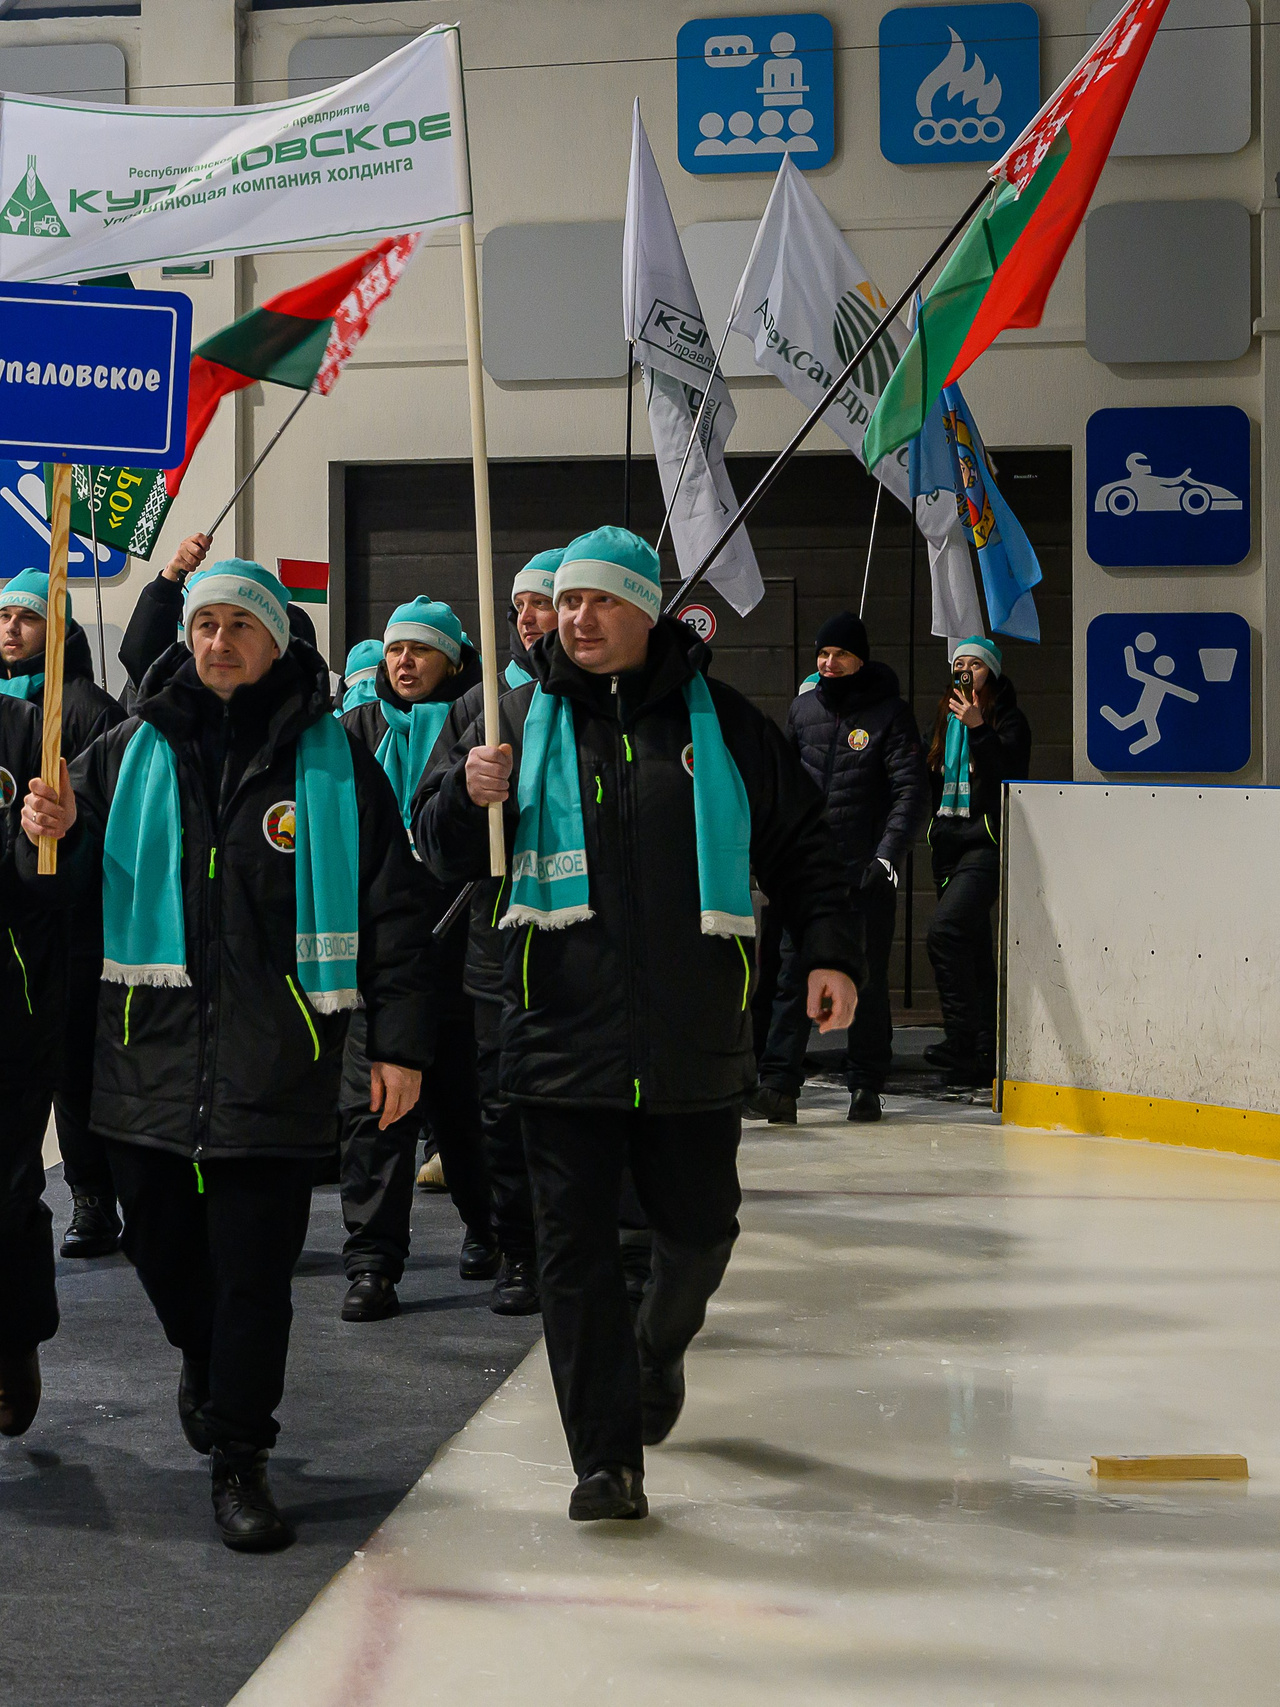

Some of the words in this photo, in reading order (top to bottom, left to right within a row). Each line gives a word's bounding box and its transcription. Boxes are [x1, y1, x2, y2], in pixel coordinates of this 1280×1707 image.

[128, 155, 234, 180] Республиканское
[292, 102, 370, 129] предприятие
[103, 186, 227, 229] Управляющая
[232, 170, 322, 196] компания
[327, 157, 414, 183] холдинга
